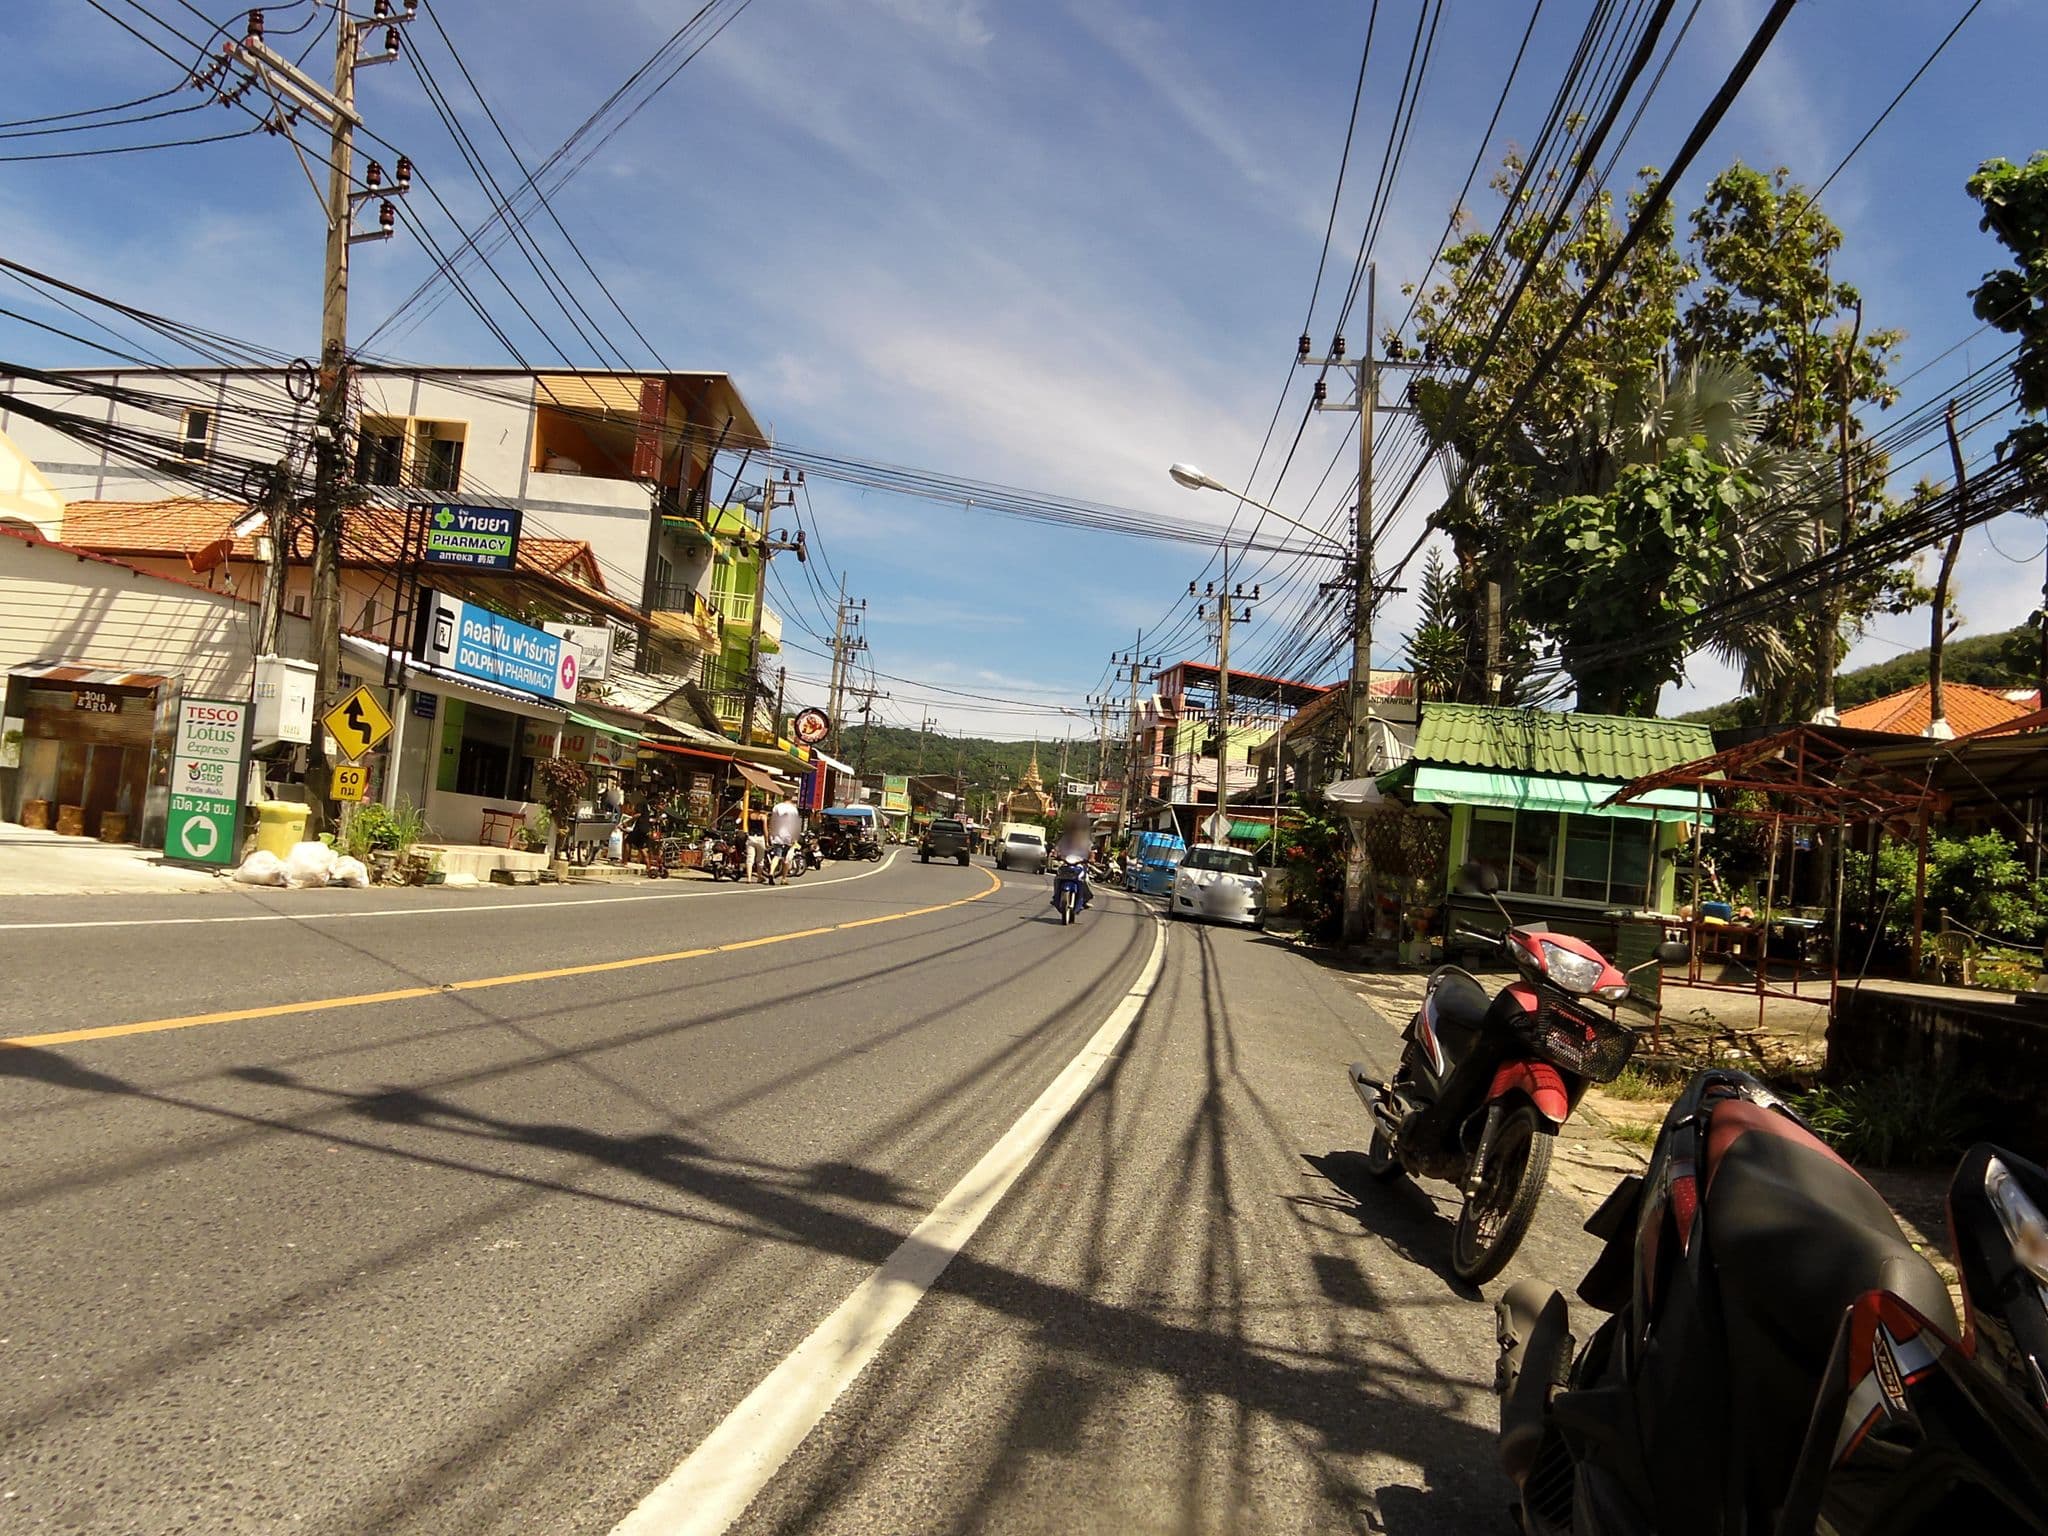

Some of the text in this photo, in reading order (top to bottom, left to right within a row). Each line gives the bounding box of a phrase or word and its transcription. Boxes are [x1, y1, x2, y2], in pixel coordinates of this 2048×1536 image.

[457, 515, 510, 533] ขายยา
[432, 534, 507, 551] PHARMACY
[459, 648, 504, 677] DOLPHIN
[504, 662, 554, 690] PHARMACY
[77, 696, 117, 714] KARON
[186, 706, 239, 722] TESCO
[186, 724, 236, 743] Lotus
[200, 762, 224, 774] one
[201, 772, 223, 784] stop
[340, 771, 359, 784] 60
[172, 796, 192, 811] เปิด
[195, 801, 211, 814] 24
